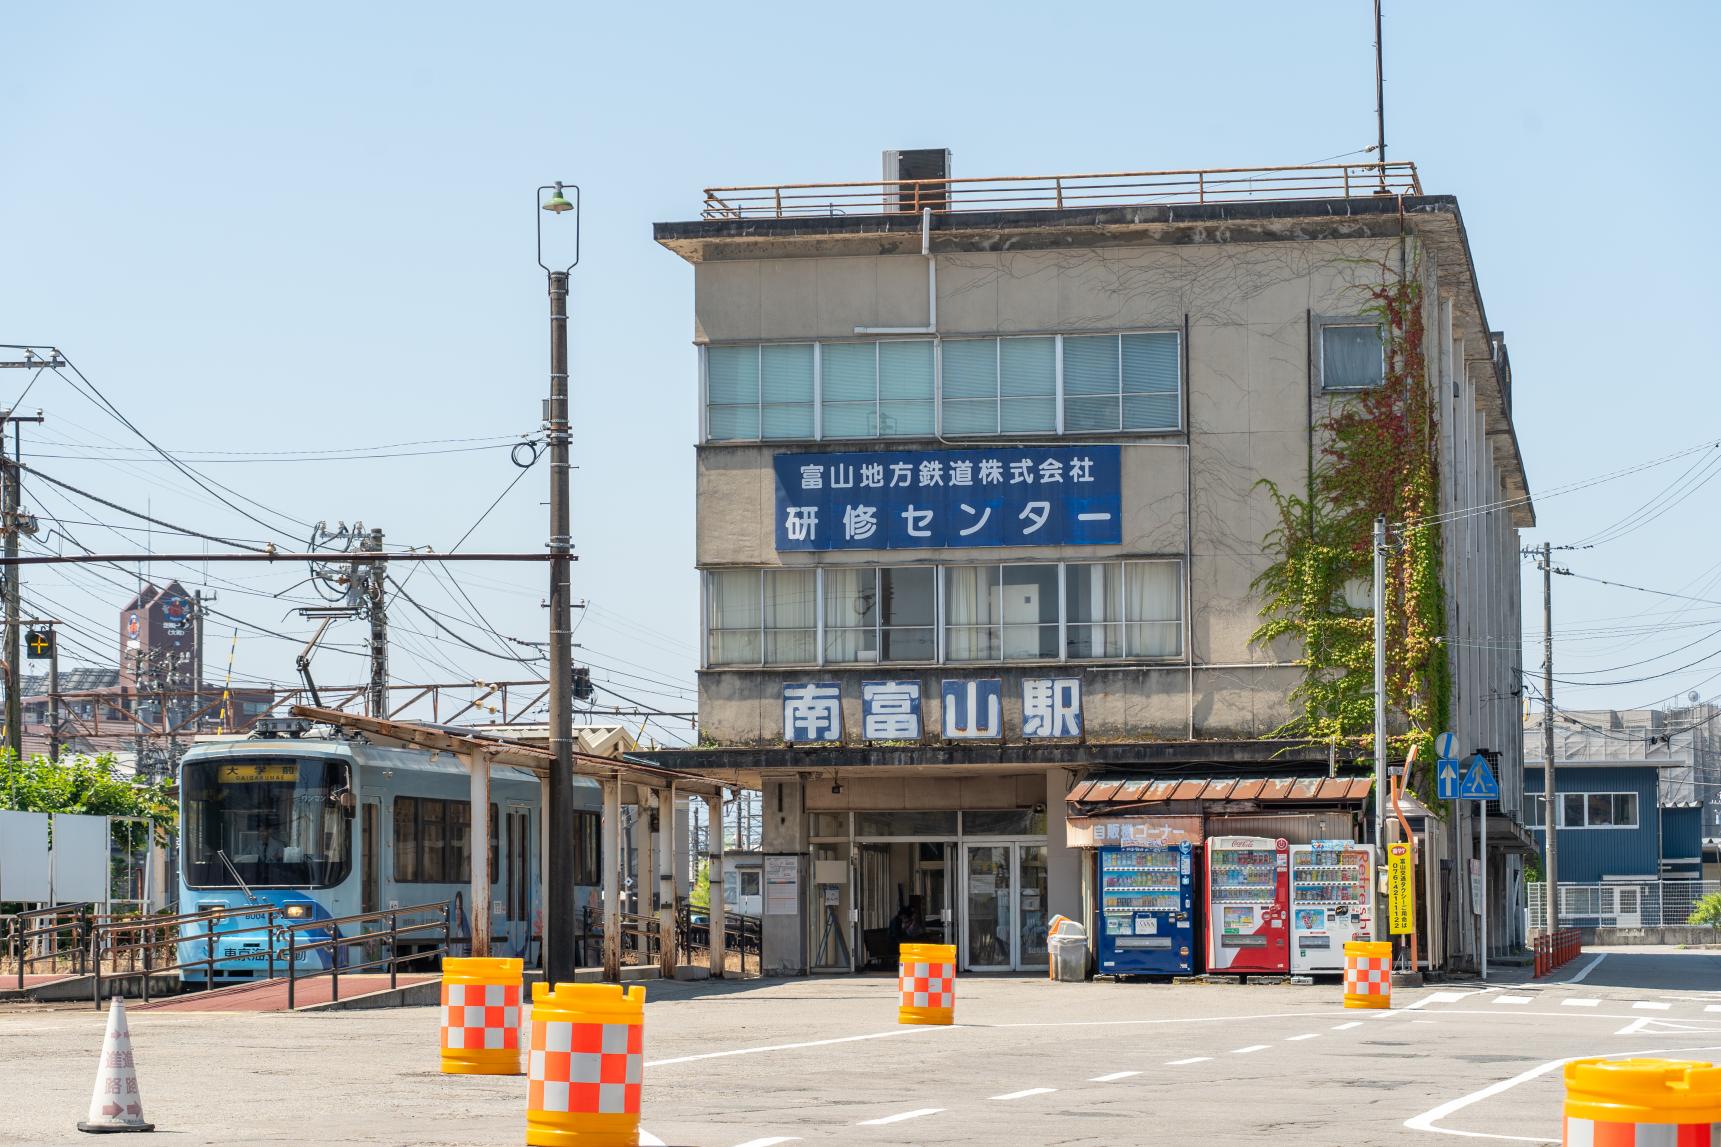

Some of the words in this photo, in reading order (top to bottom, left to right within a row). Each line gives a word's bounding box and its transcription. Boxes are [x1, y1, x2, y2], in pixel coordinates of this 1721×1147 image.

[800, 456, 1094, 490] 富山地方鉄道株式会社
[785, 500, 1112, 541] 研修センター
[784, 679, 1081, 740] 南富山駅
[1093, 823, 1185, 840] 自販機コーナー
